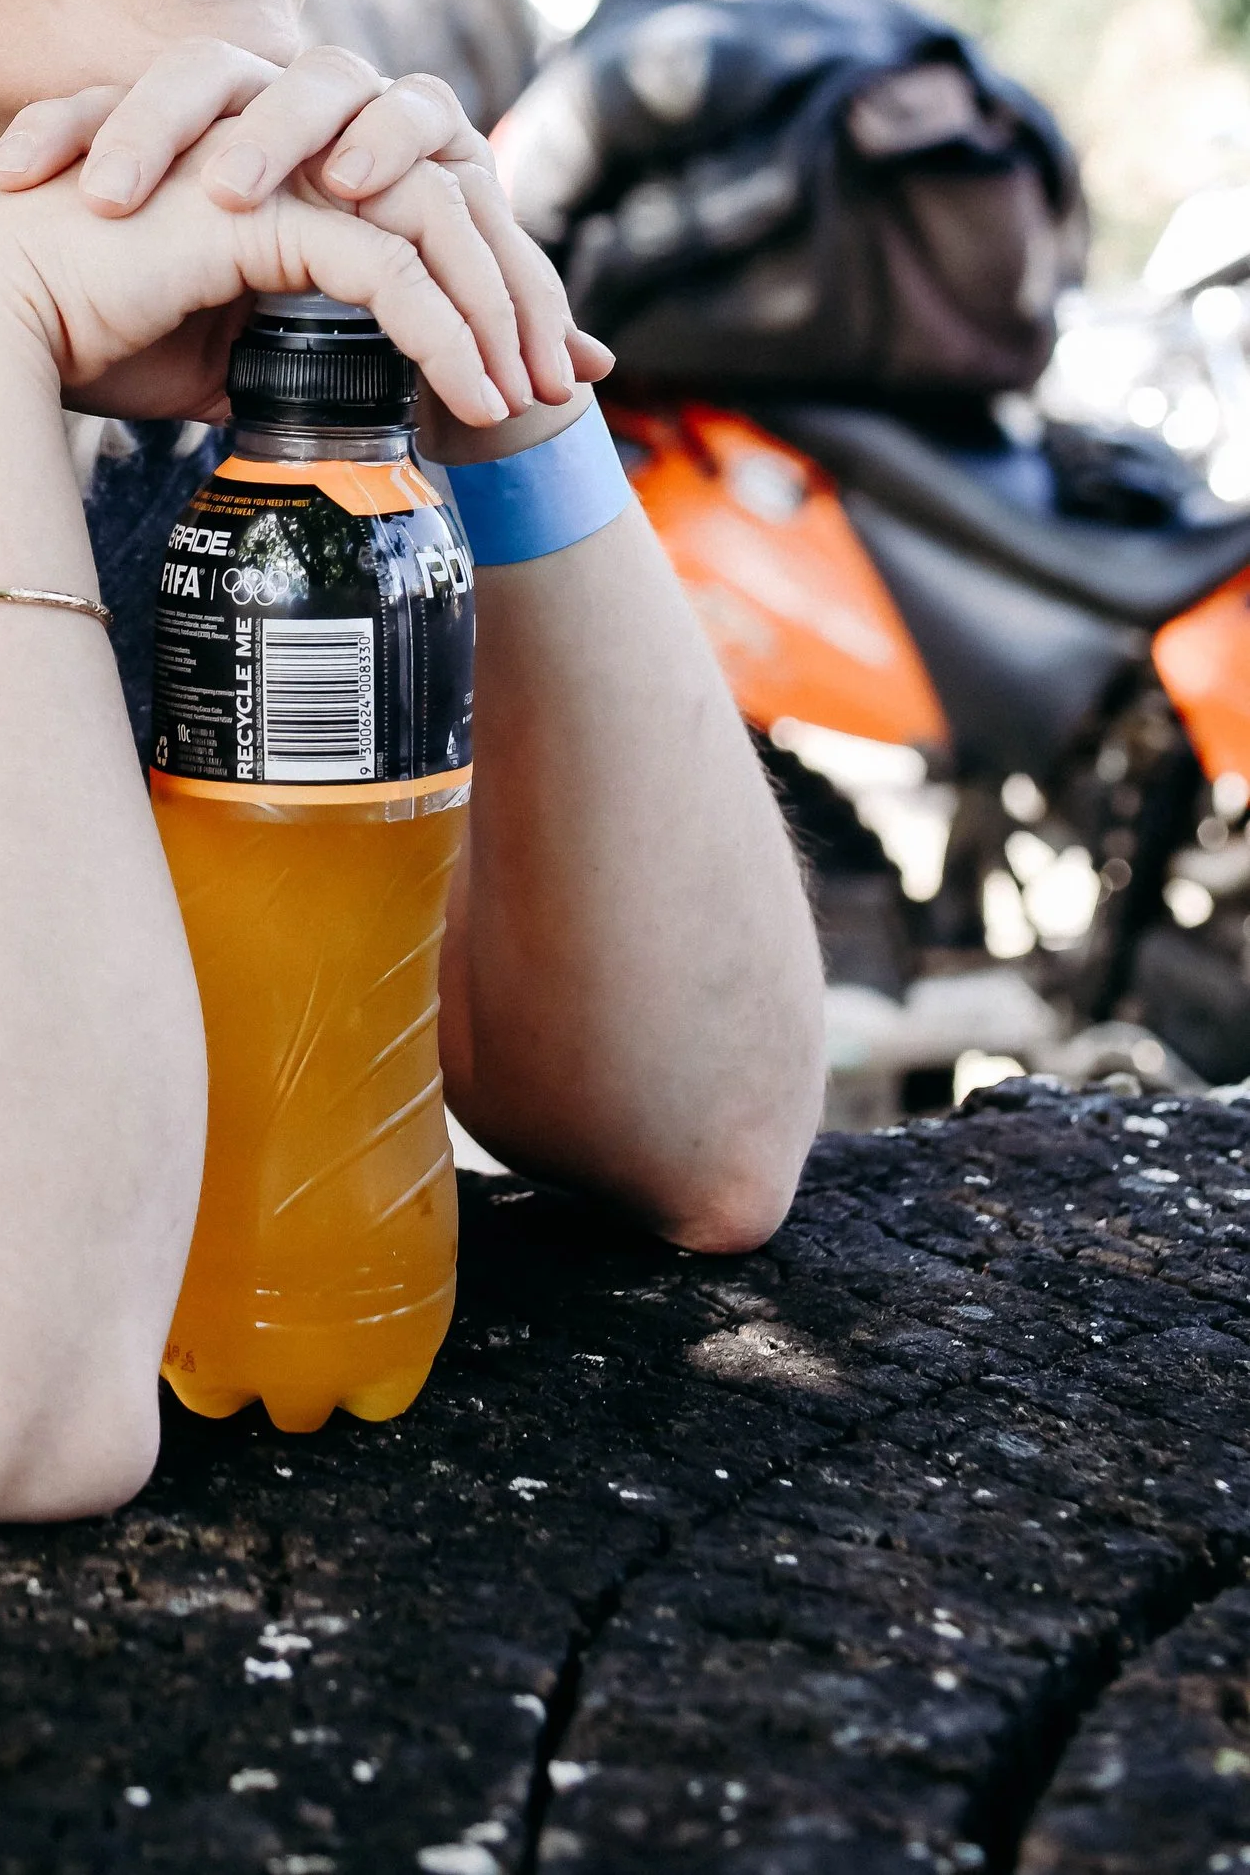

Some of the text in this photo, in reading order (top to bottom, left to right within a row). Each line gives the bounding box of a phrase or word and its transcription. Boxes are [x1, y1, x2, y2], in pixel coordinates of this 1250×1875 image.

[234, 496, 252, 505] WHEN
[253, 498, 265, 506] YOU
[266, 498, 283, 507] NEED
[284, 499, 291, 507] IT
[292, 499, 310, 507] MOST
[160, 562, 201, 599] FIFA
[236, 617, 253, 779] RECYCLE ME
[359, 636, 372, 775] 9 300624 008330
[177, 723, 191, 743] 10c
